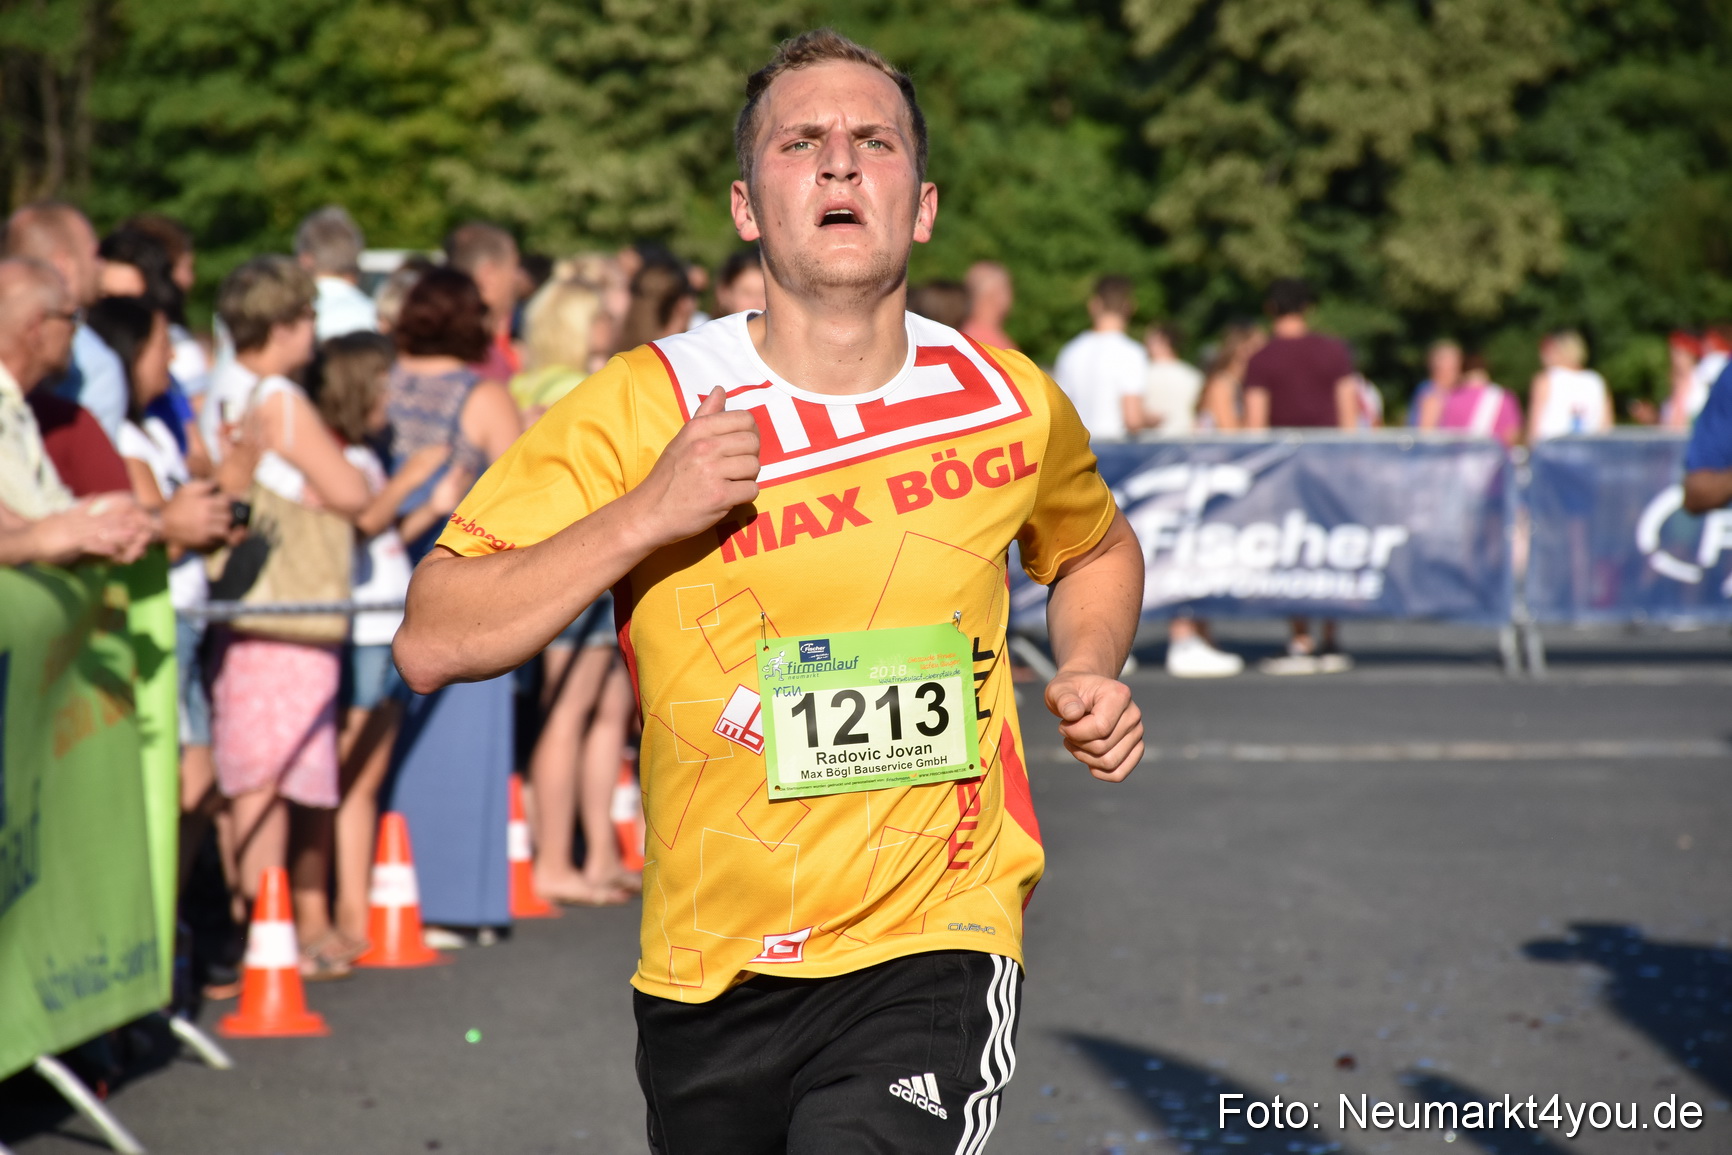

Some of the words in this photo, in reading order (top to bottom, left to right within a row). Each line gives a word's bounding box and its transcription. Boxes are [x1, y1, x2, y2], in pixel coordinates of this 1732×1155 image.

[716, 486, 872, 564] MAX
[886, 441, 1038, 515] BÖGL
[1143, 509, 1409, 569] Fischer
[787, 656, 859, 674] firmenlauf
[869, 664, 908, 679] 2018
[791, 681, 949, 748] 1213
[801, 769, 823, 779] Max
[826, 766, 851, 778] Bögl
[854, 761, 913, 775] Bauservice
[916, 756, 948, 768] GmbH
[816, 748, 881, 766] Radovic
[886, 743, 933, 760] Jovan
[889, 1083, 948, 1120] adidas
